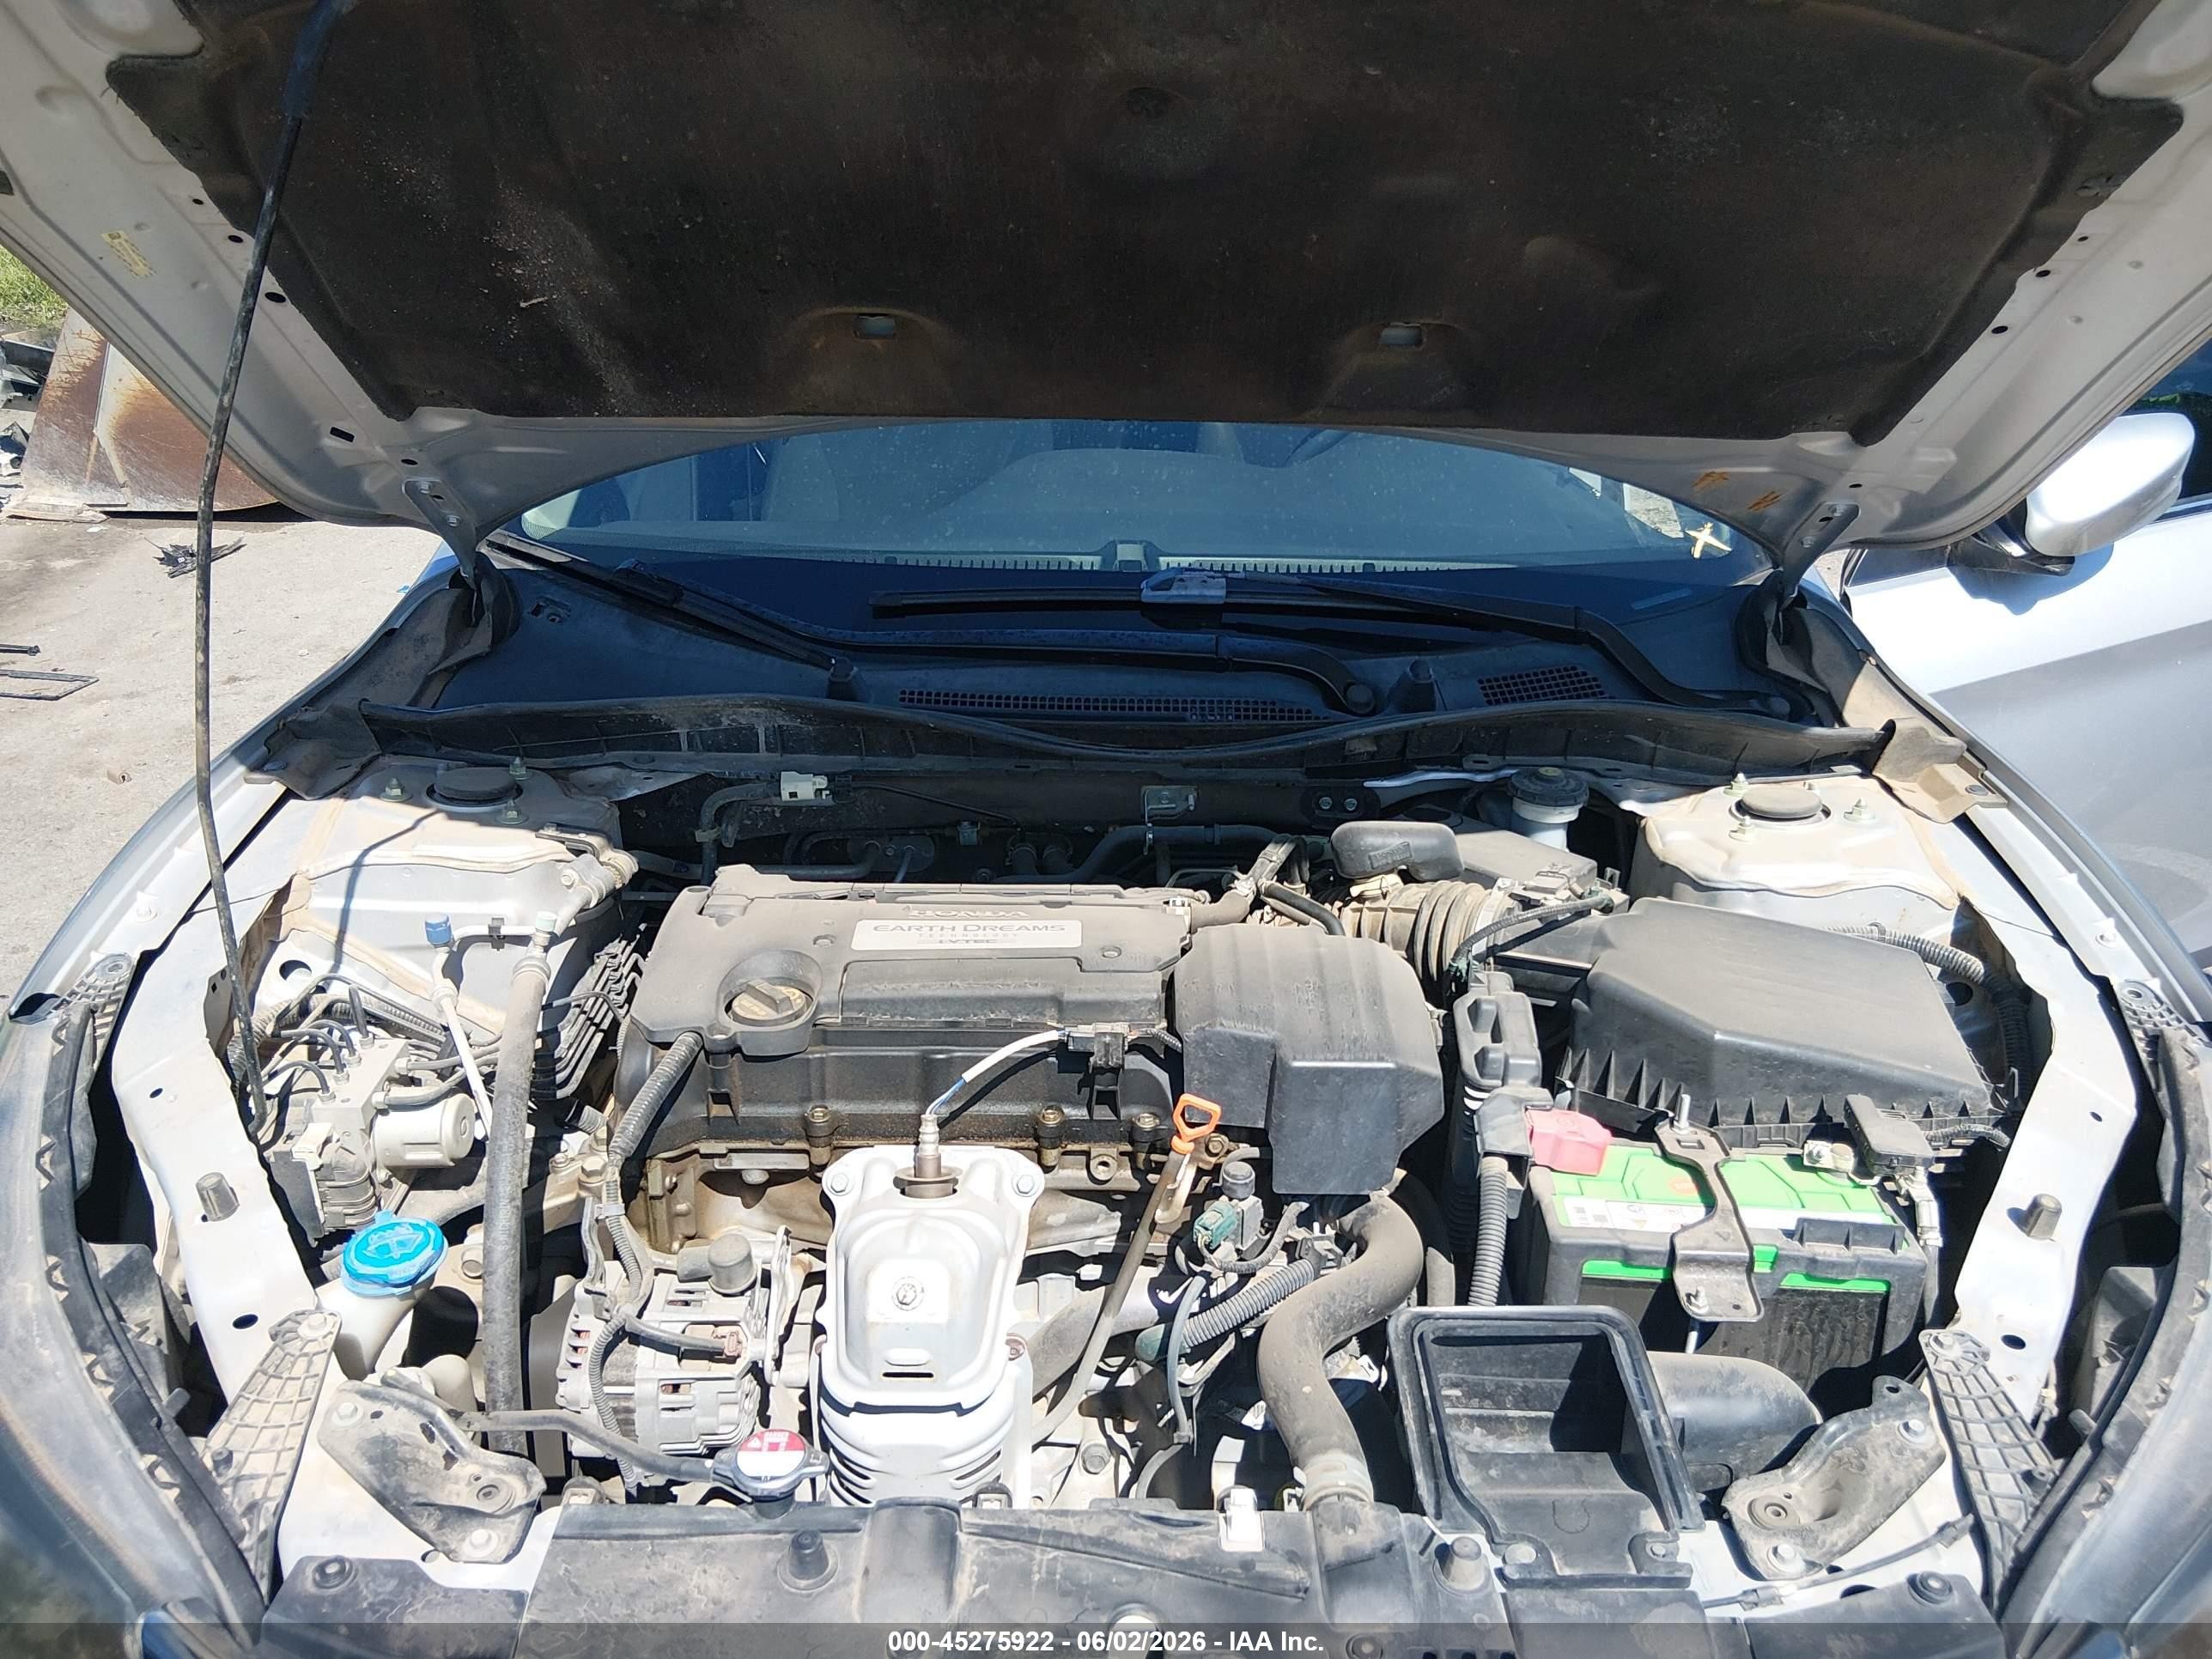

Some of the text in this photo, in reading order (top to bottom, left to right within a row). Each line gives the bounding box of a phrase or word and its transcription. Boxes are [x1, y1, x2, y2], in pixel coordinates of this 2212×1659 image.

[908, 909, 1031, 919] HONDA
[873, 923, 1066, 933] EARTH DREAMS
